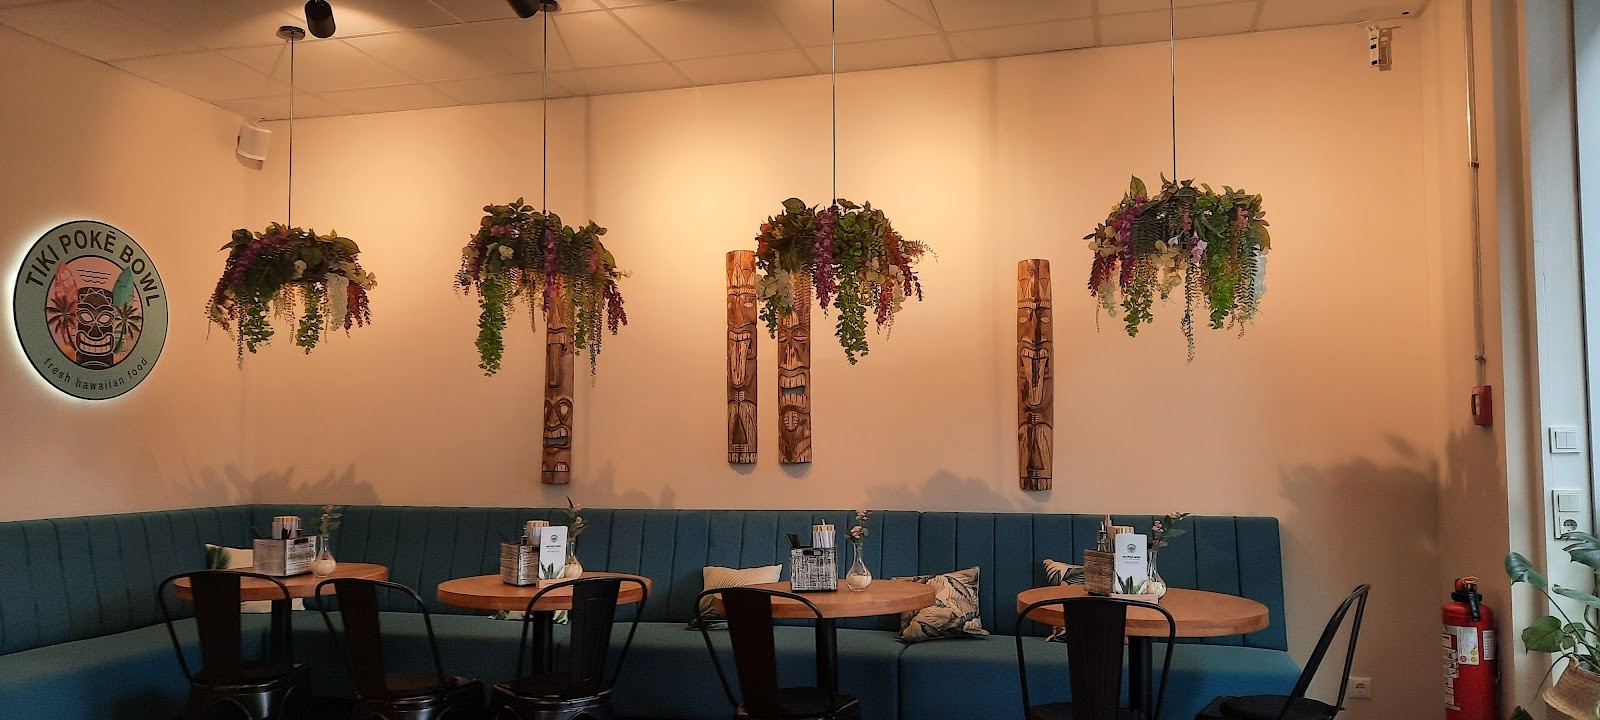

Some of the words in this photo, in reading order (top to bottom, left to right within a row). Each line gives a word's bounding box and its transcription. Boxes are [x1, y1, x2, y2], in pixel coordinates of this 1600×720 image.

[25, 244, 60, 287] TIKI
[119, 244, 160, 307] BOWL
[43, 357, 71, 383] fresh
[75, 377, 125, 391] hawaiian
[127, 358, 148, 380] food
